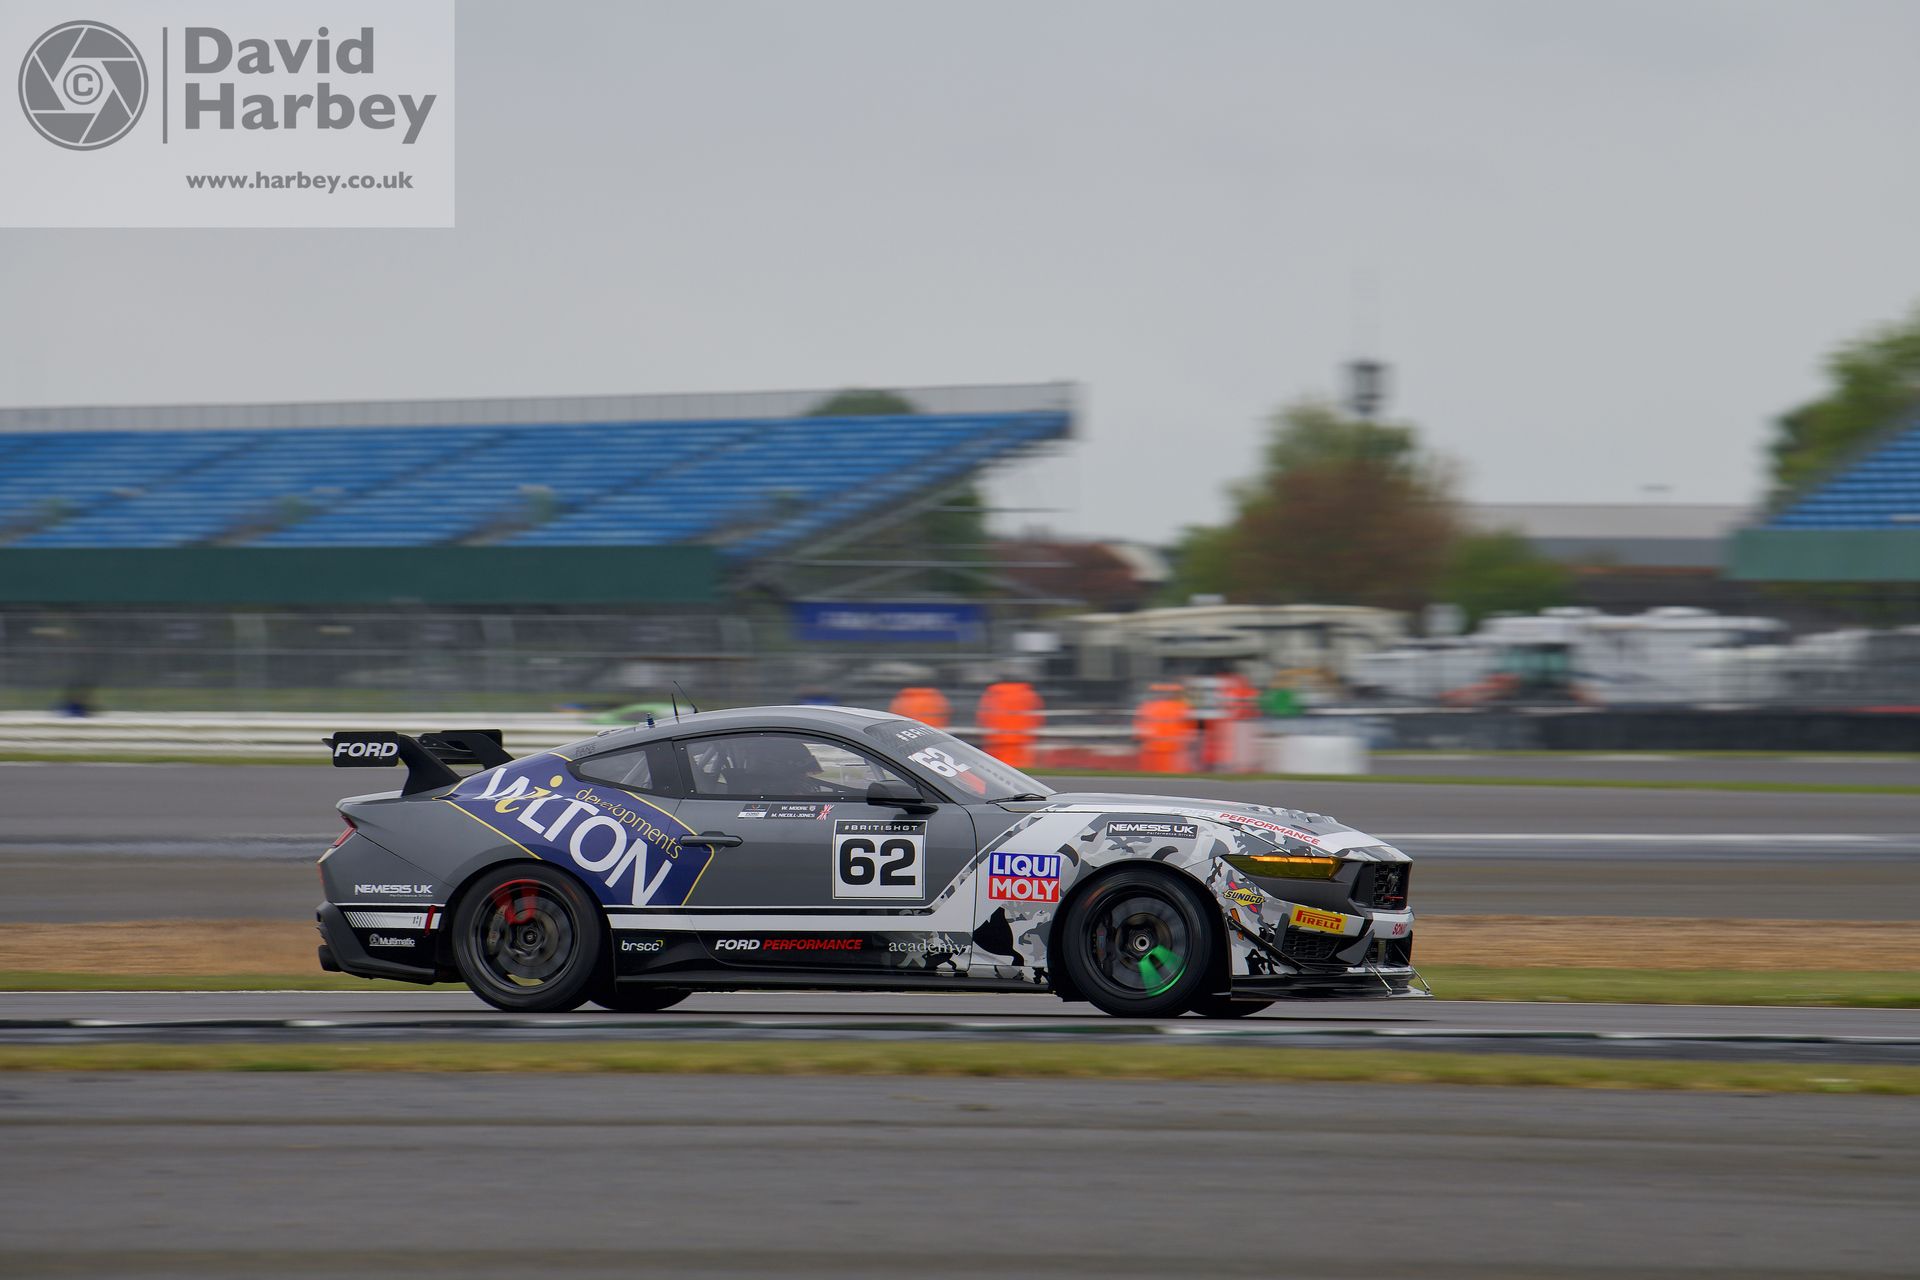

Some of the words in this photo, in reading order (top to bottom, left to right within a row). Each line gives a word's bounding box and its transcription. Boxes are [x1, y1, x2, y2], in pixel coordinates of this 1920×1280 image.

[334, 742, 398, 757] FORD
[907, 747, 972, 778] 62
[575, 788, 682, 859] developments
[1109, 823, 1172, 834] NEMESIS
[1174, 825, 1195, 834] UK
[1219, 813, 1320, 846] PERFORMANCE
[839, 838, 916, 886] 62
[992, 854, 1058, 877] LIQUI
[354, 884, 412, 895] NEMESIS
[413, 884, 433, 894] UK
[991, 878, 1058, 900] MOLY
[1225, 891, 1263, 904] SUNOCO
[1296, 910, 1342, 930] PIRELLI
[379, 937, 416, 946] Multimatic
[621, 940, 663, 951] brscc
[715, 939, 760, 950] FORD
[763, 939, 863, 950] PERFORMANCE
[888, 939, 966, 956] academy
